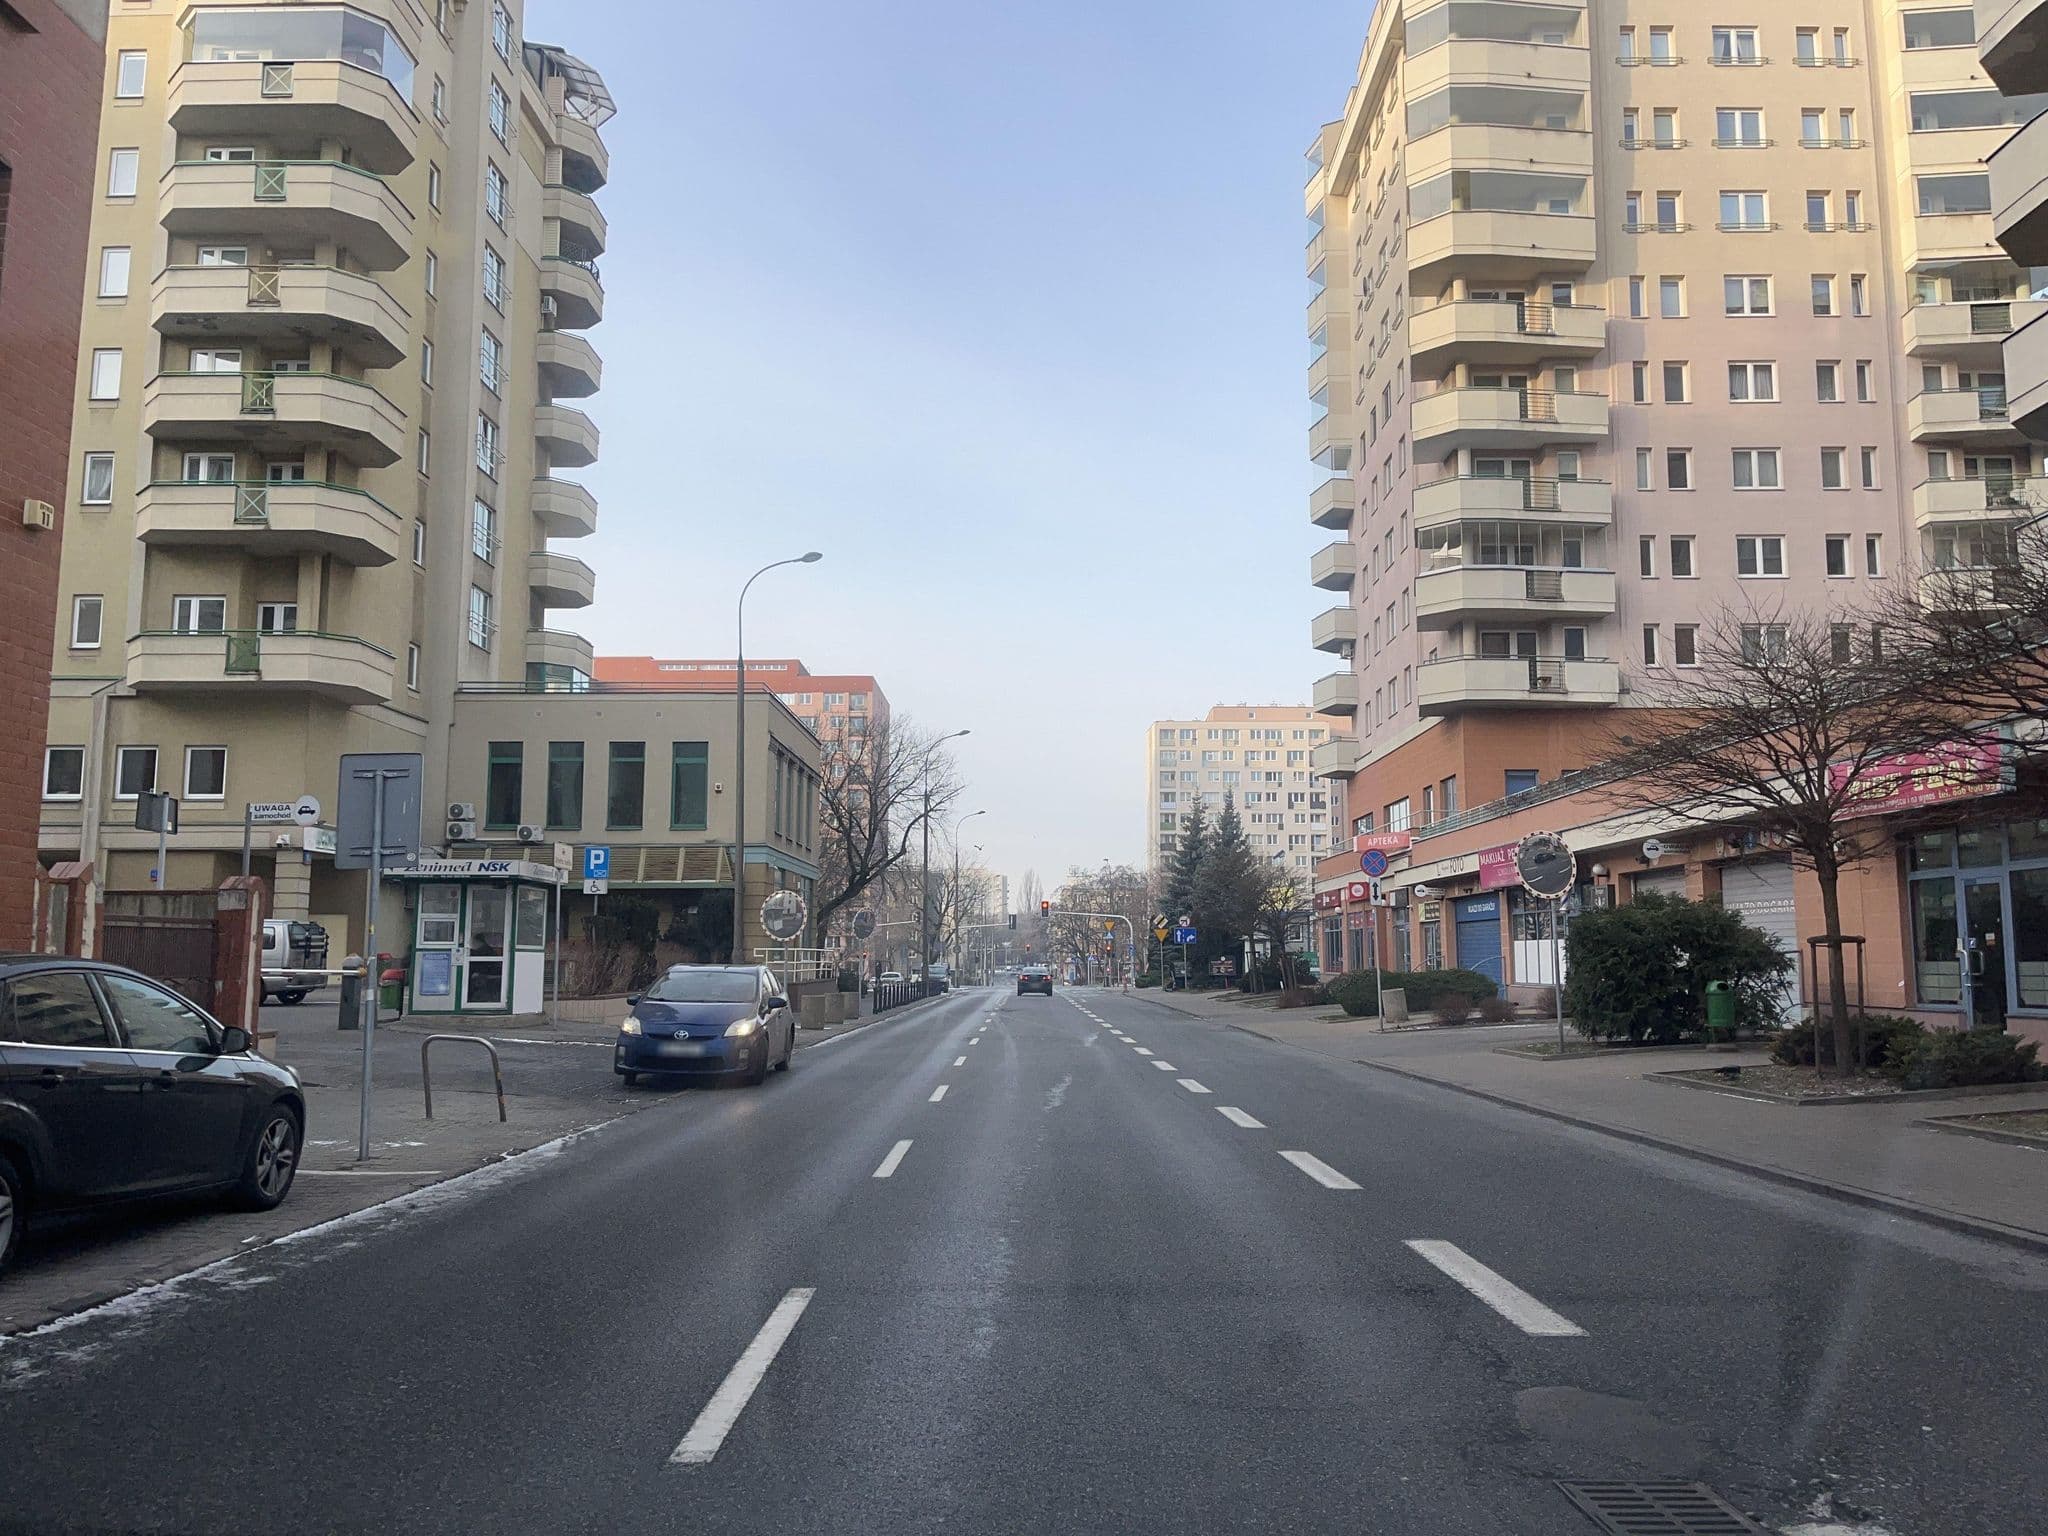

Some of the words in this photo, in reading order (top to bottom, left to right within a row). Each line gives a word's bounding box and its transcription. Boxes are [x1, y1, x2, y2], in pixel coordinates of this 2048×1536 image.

[254, 804, 291, 812] UWAGA
[1367, 835, 1399, 847] APTEKA
[590, 849, 605, 870] P
[478, 861, 511, 872] NSK
